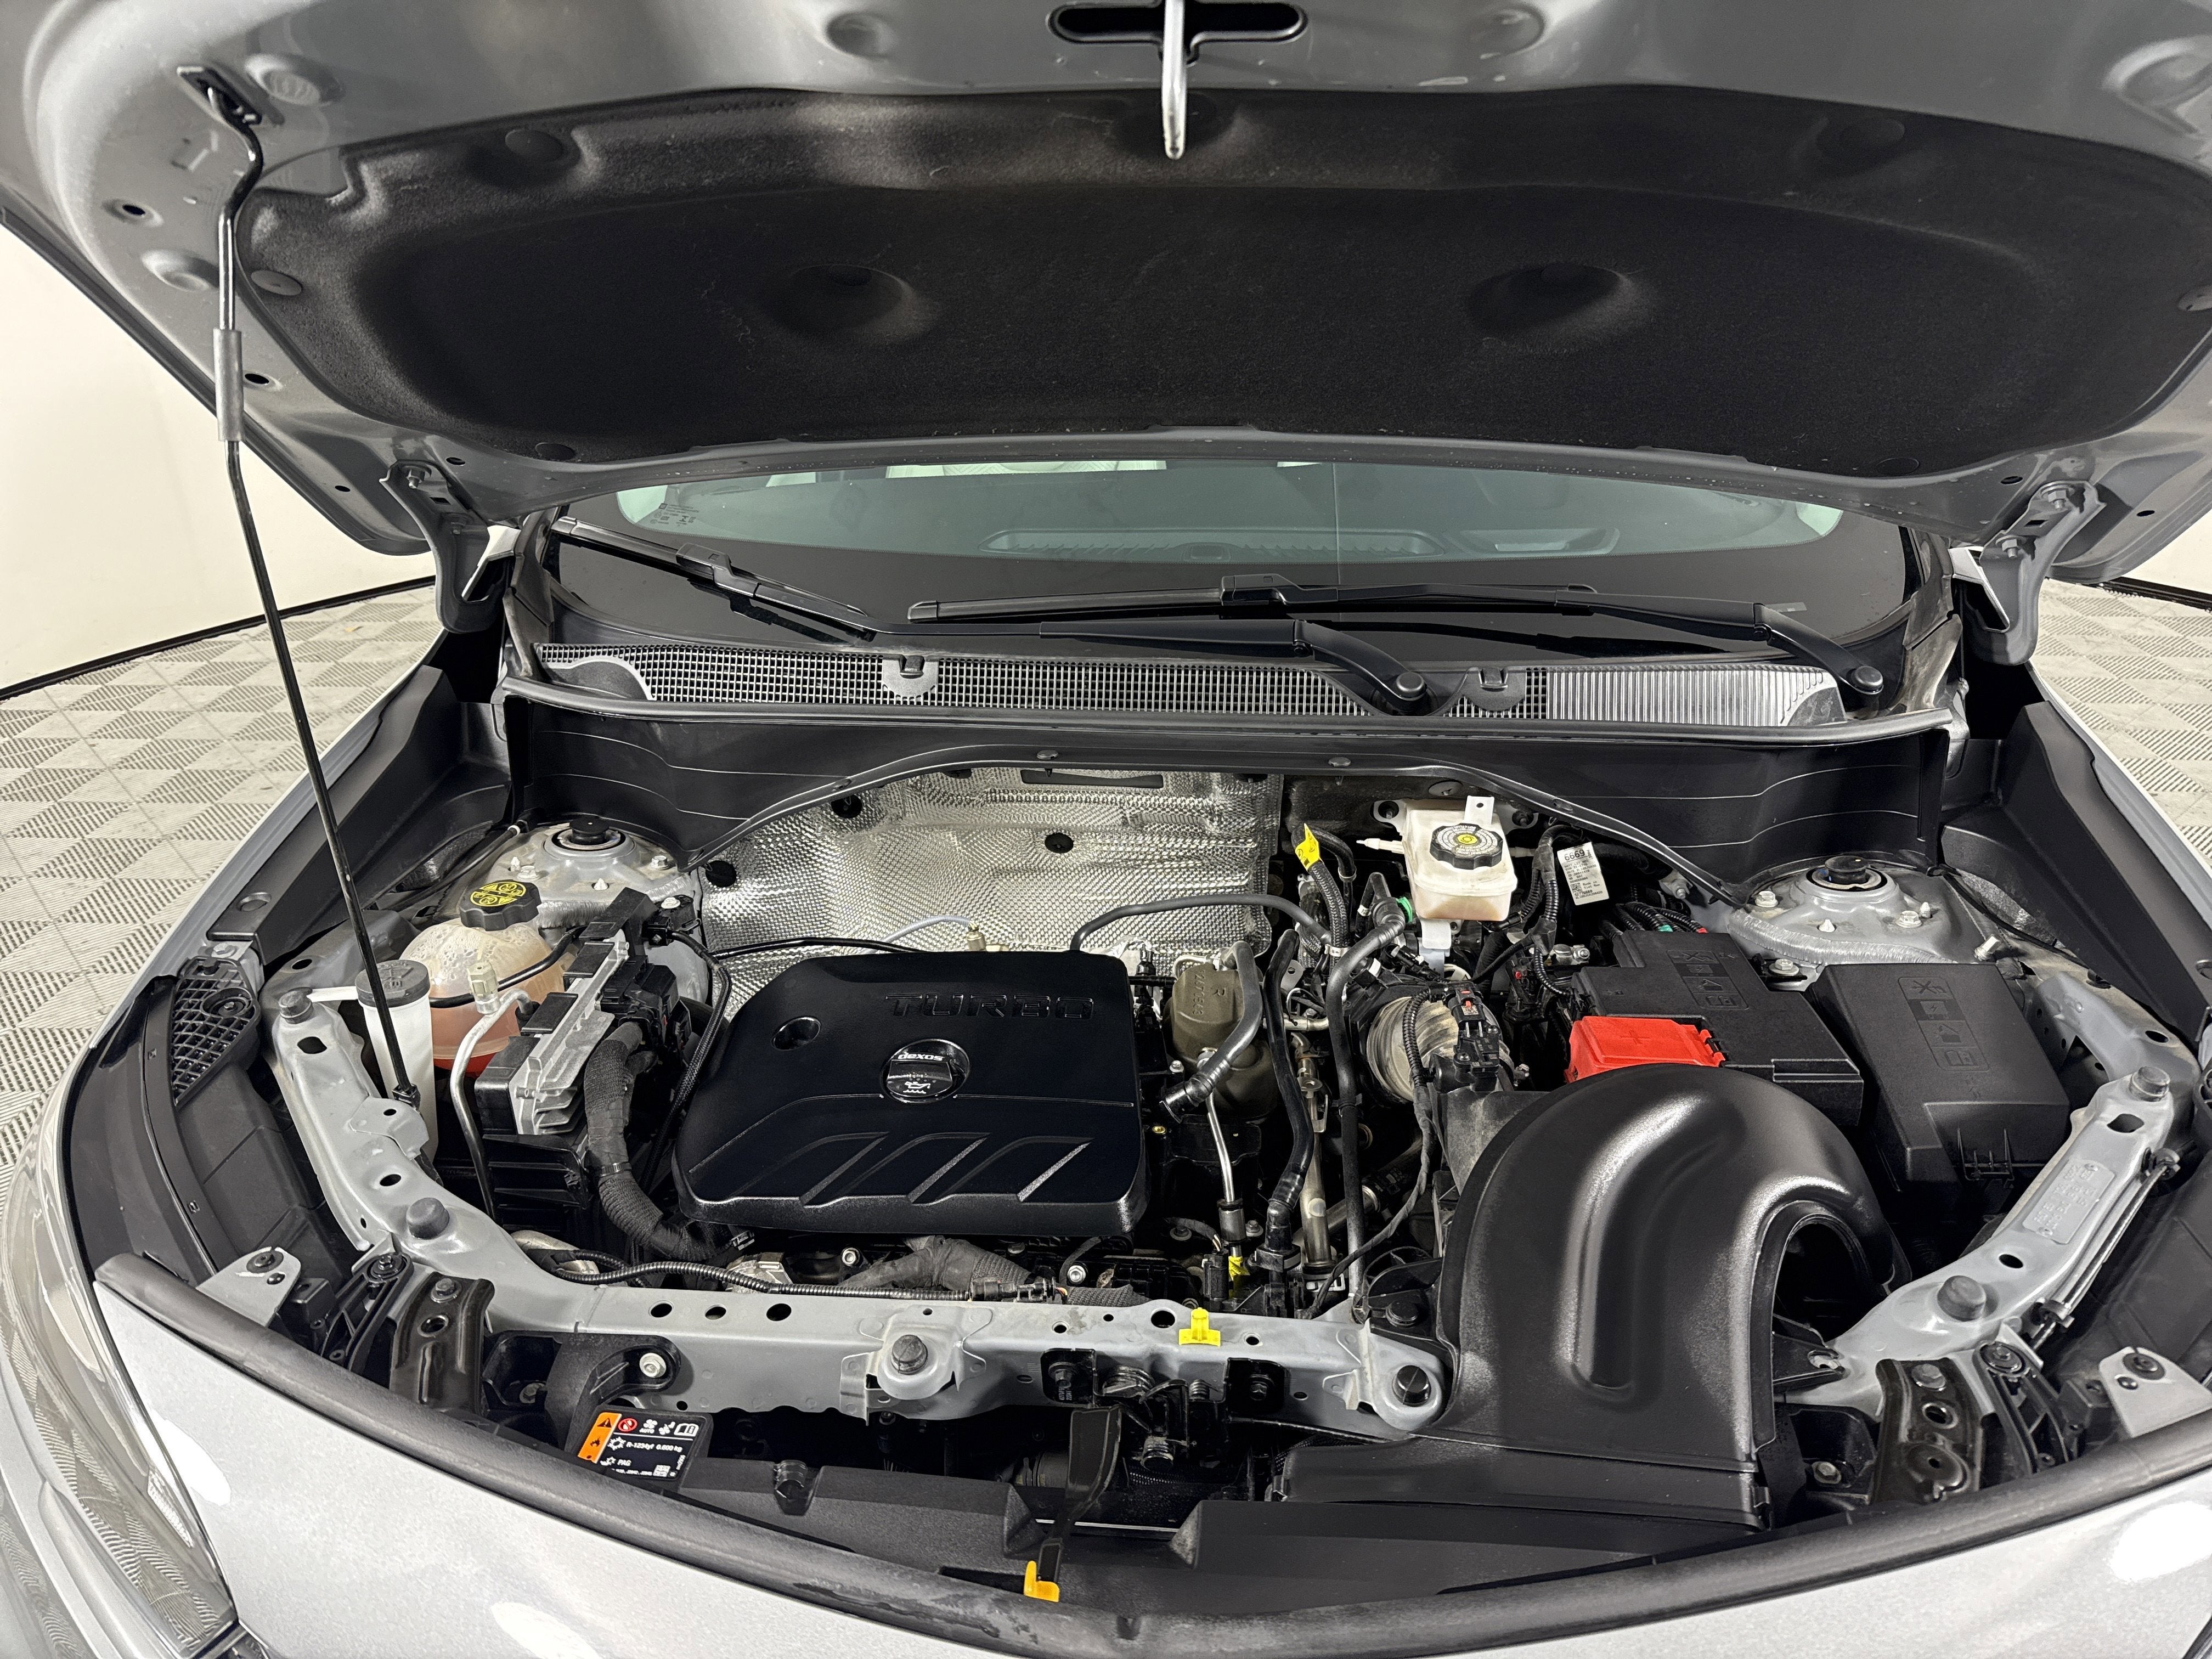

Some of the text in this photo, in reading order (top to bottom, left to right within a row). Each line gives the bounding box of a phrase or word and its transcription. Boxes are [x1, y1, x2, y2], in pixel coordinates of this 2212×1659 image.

[1564, 849, 1585, 861] 6669
[885, 994, 1095, 1020] TURBO
[898, 1052, 945, 1062] dexos
[626, 1442, 654, 1451] R-1234yf
